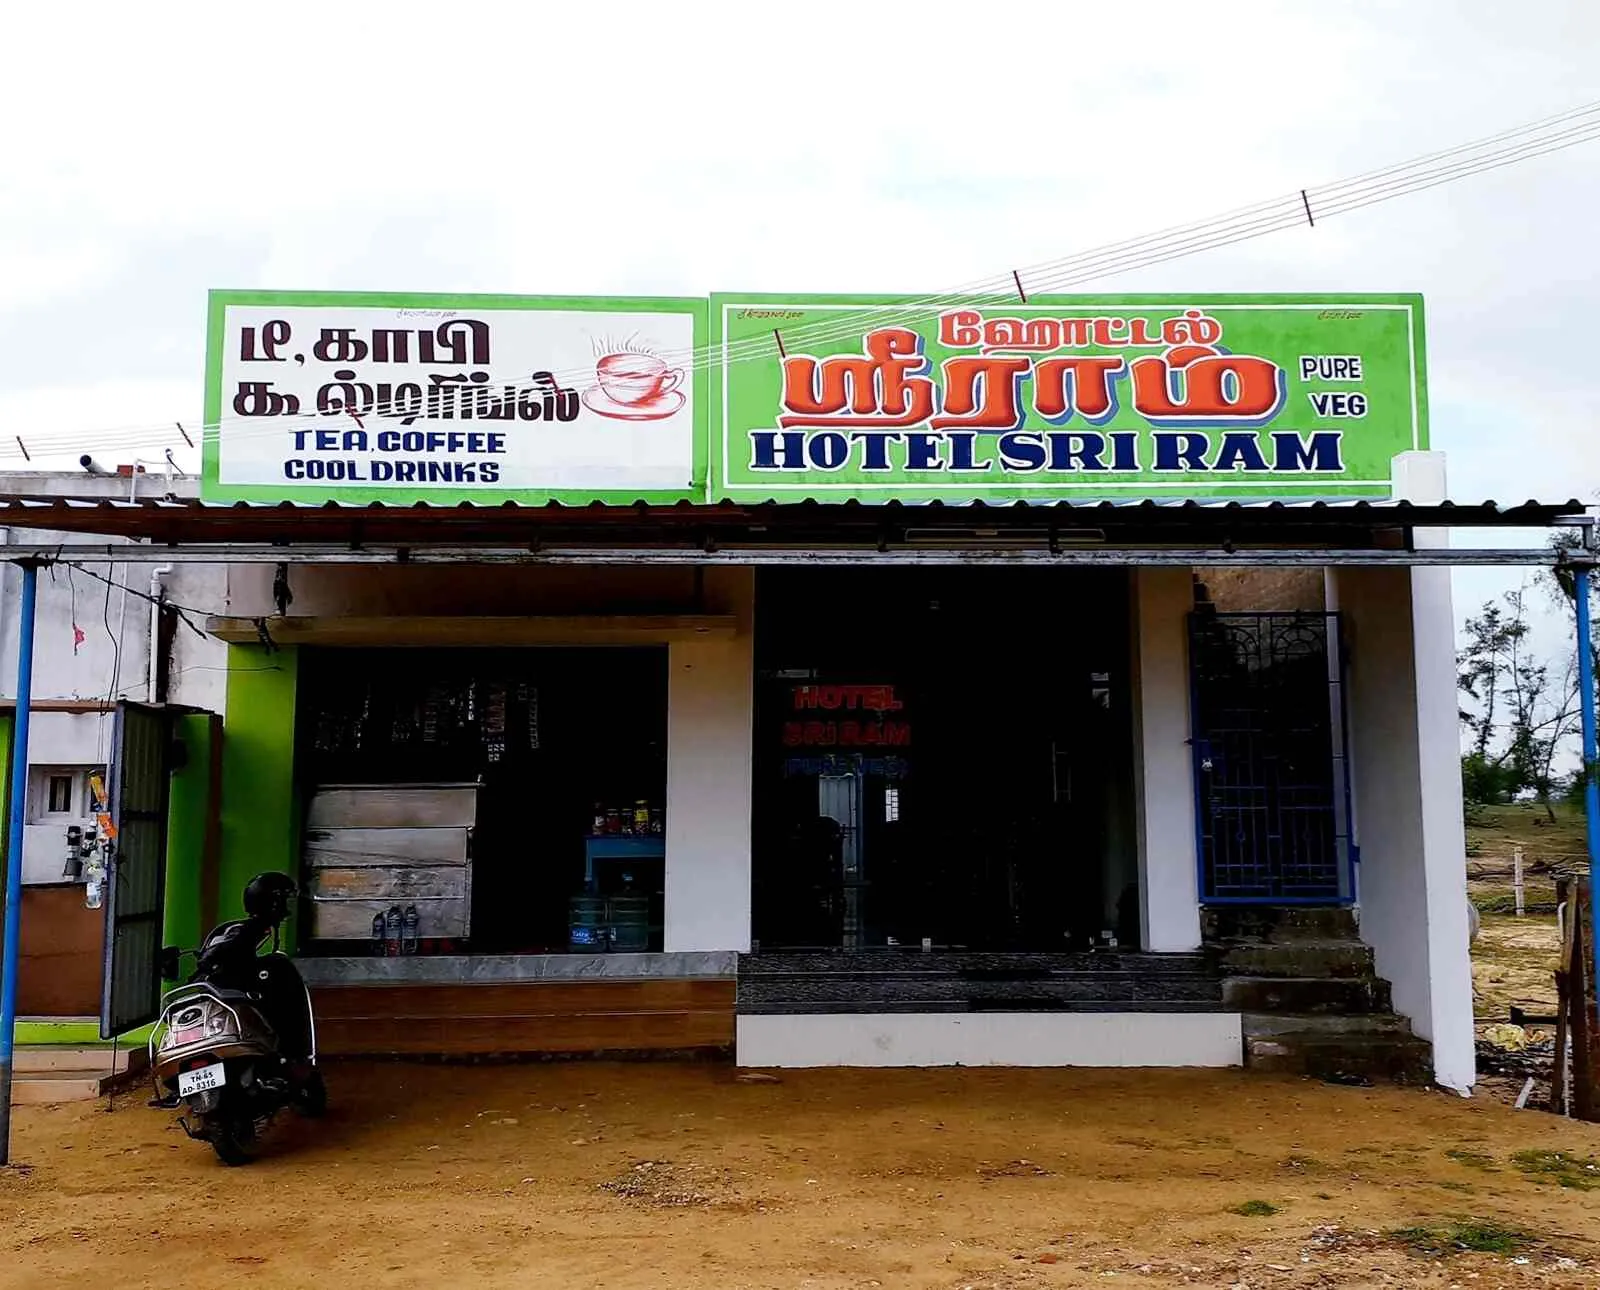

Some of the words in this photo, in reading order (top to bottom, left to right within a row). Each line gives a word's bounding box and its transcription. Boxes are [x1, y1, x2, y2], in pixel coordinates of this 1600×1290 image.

[940, 309, 1221, 352] ஹோட்டல்
[1301, 357, 1361, 379] PURE
[1310, 393, 1366, 416] VEG
[749, 432, 992, 470] HOTEL
[999, 432, 1139, 471] SRI
[1152, 432, 1344, 471] RAM
[793, 685, 904, 710] HOTEL
